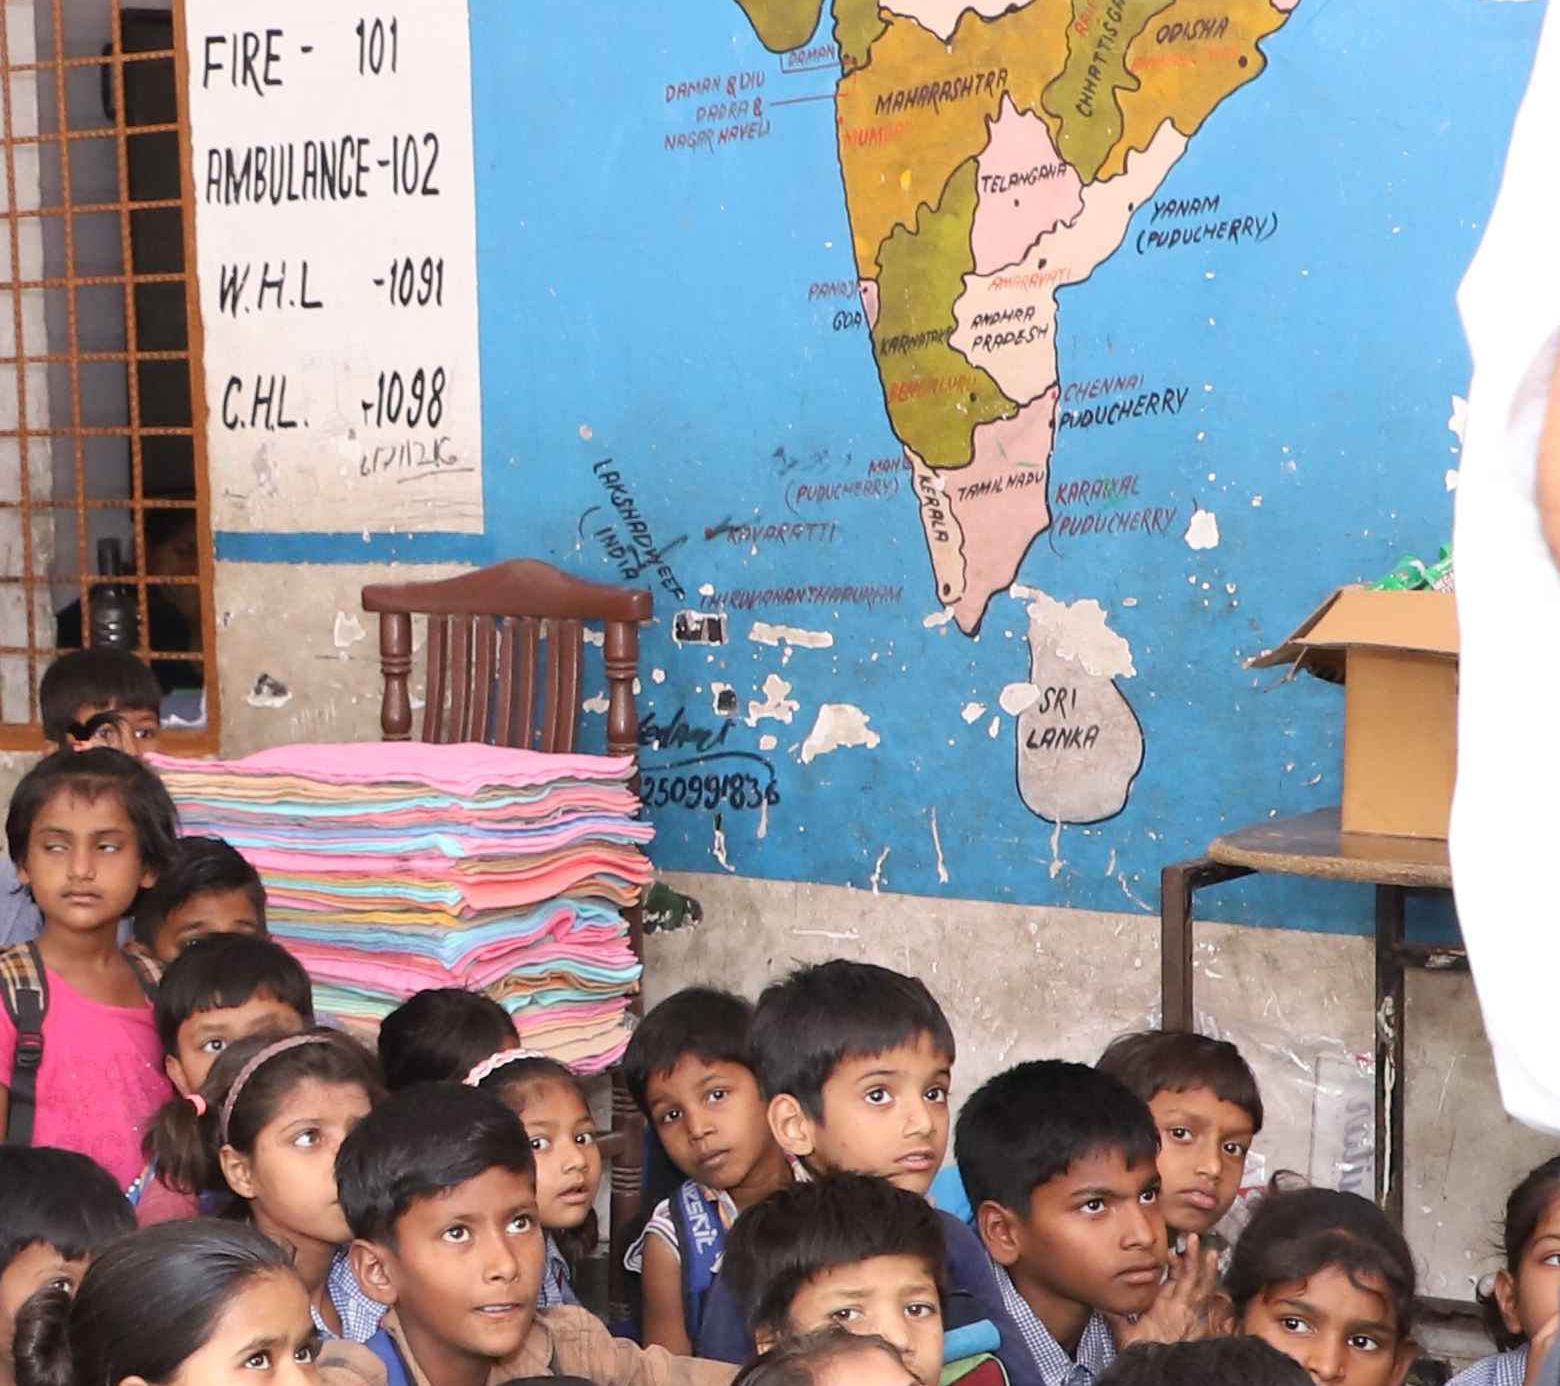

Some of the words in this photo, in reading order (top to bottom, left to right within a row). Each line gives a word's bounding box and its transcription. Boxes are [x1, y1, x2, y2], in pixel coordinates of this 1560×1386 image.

[1156, 16, 1230, 45] ODISHA
[202, 27, 284, 96] FIRE
[357, 15, 399, 75] 101
[788, 43, 836, 68] DAMAN
[664, 76, 722, 103] DAMAN
[874, 68, 1010, 117] MAHARASHTRA
[696, 102, 749, 124] DADRA
[664, 125, 716, 155] NAGAR
[981, 162, 1068, 194] TELANGANA
[1151, 194, 1222, 225] YANAM
[1135, 211, 1278, 255] (PUDUCHERRY)
[833, 310, 863, 332] GOA
[971, 306, 1036, 332] ANDHRA
[971, 324, 1049, 353] PRADESH
[1063, 373, 1144, 403] CHENNAI
[1058, 386, 1190, 432] PUDUCHERRY
[918, 473, 950, 543] KERALA
[1039, 686, 1077, 719] SRI
[1026, 724, 1100, 750] LANKA
